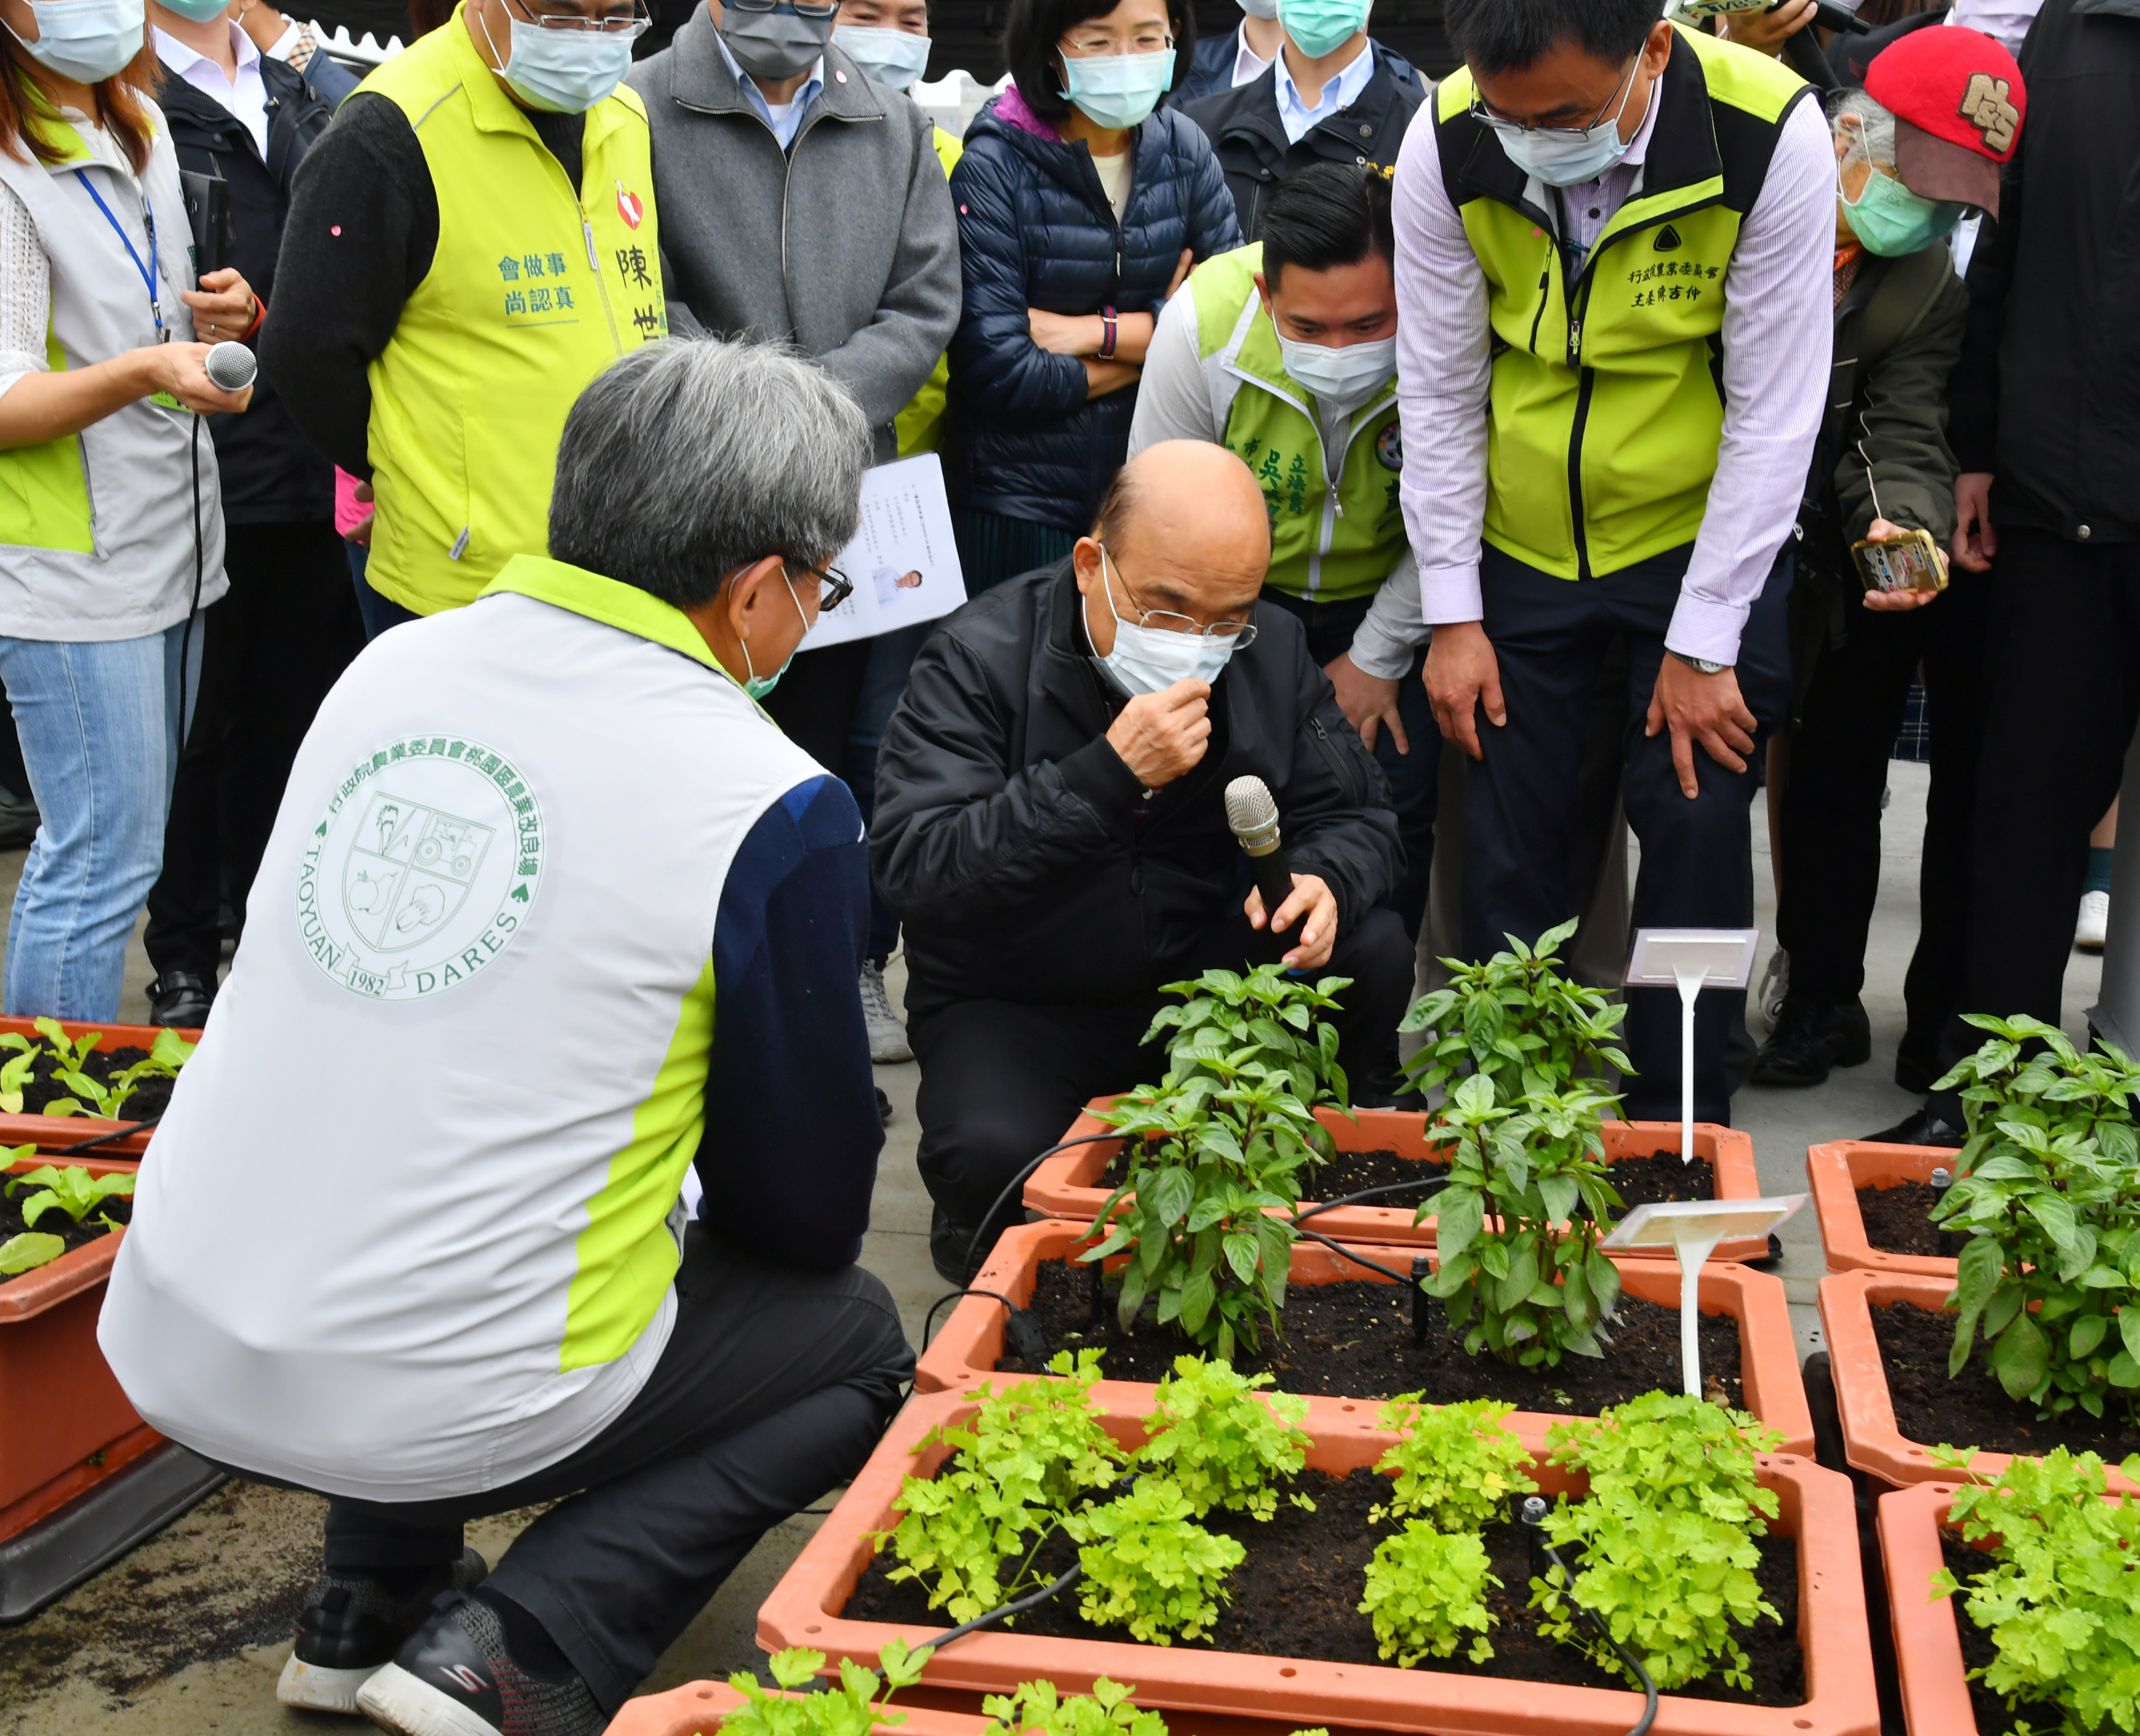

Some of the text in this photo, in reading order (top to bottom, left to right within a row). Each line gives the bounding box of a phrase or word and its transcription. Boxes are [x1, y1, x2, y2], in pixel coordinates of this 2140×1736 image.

[498, 252, 566, 281] 會做事
[504, 286, 574, 315] 尚認真
[329, 738, 540, 876] 行政院農業委員會桃園區農業改良場
[299, 844, 342, 970] TAOYUAN
[416, 912, 518, 994] DARES
[349, 970, 384, 995] 1982
